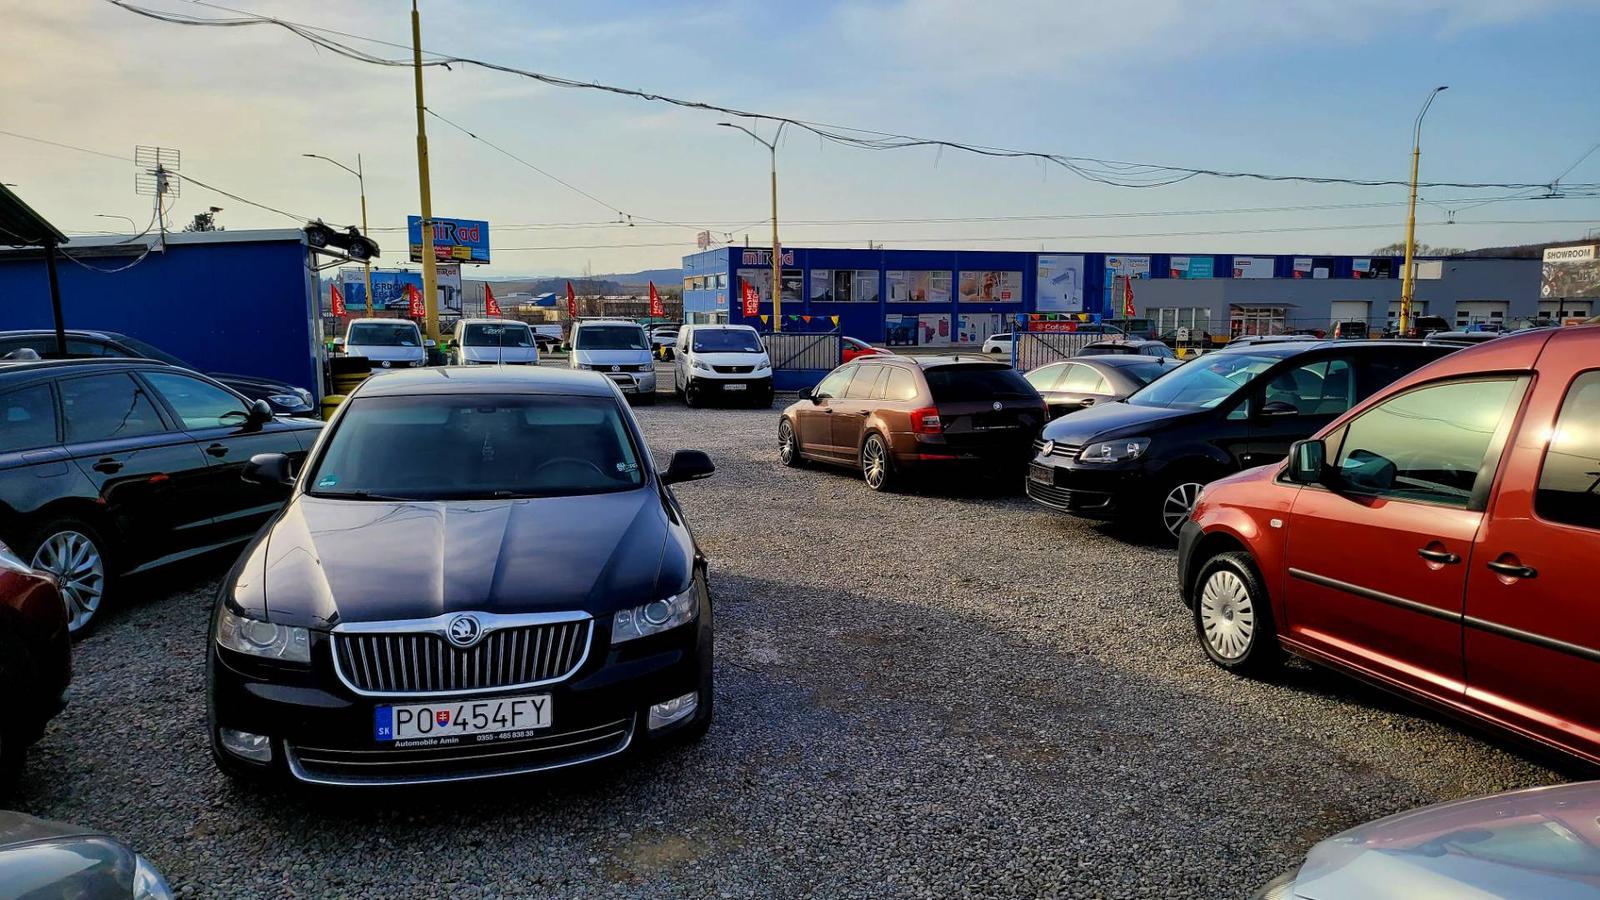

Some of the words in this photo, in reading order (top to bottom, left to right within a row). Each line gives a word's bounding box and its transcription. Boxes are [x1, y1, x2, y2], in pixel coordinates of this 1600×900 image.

[1546, 248, 1591, 260] SHOWROOM
[378, 727, 390, 736] SK
[395, 739, 438, 748] Automobile
[439, 737, 459, 745] Amin
